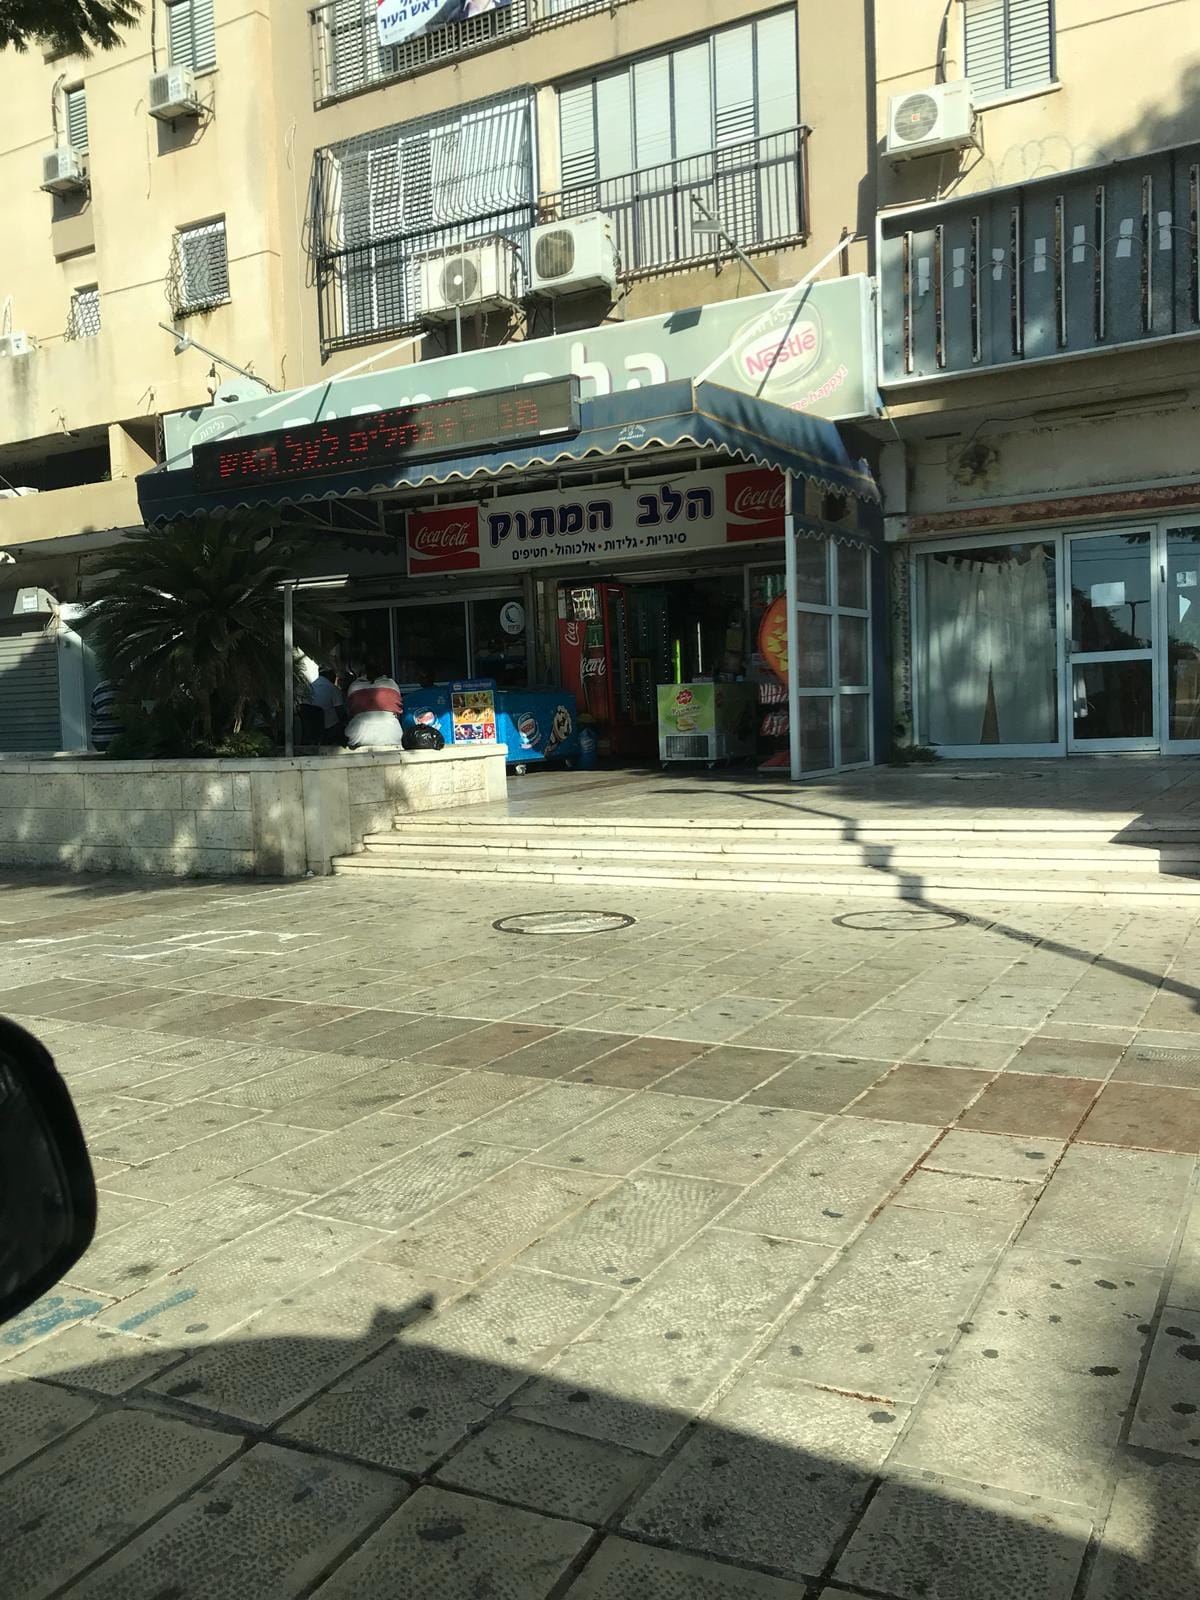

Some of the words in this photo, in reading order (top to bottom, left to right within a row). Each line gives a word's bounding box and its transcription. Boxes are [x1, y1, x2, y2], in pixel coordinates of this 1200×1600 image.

[380, 8, 407, 30] העיר
[745, 327, 817, 377] Nestlé
[198, 420, 225, 442] גלידות
[284, 426, 340, 465] לעל
[636, 482, 714, 528] הלב
[487, 498, 614, 549] המתוק
[414, 521, 471, 551] Coca-Cola
[604, 536, 639, 552] גלידות
[645, 532, 687, 549] סיגריות
[511, 547, 548, 561] חטיפים
[554, 540, 597, 558] אלכוהול
